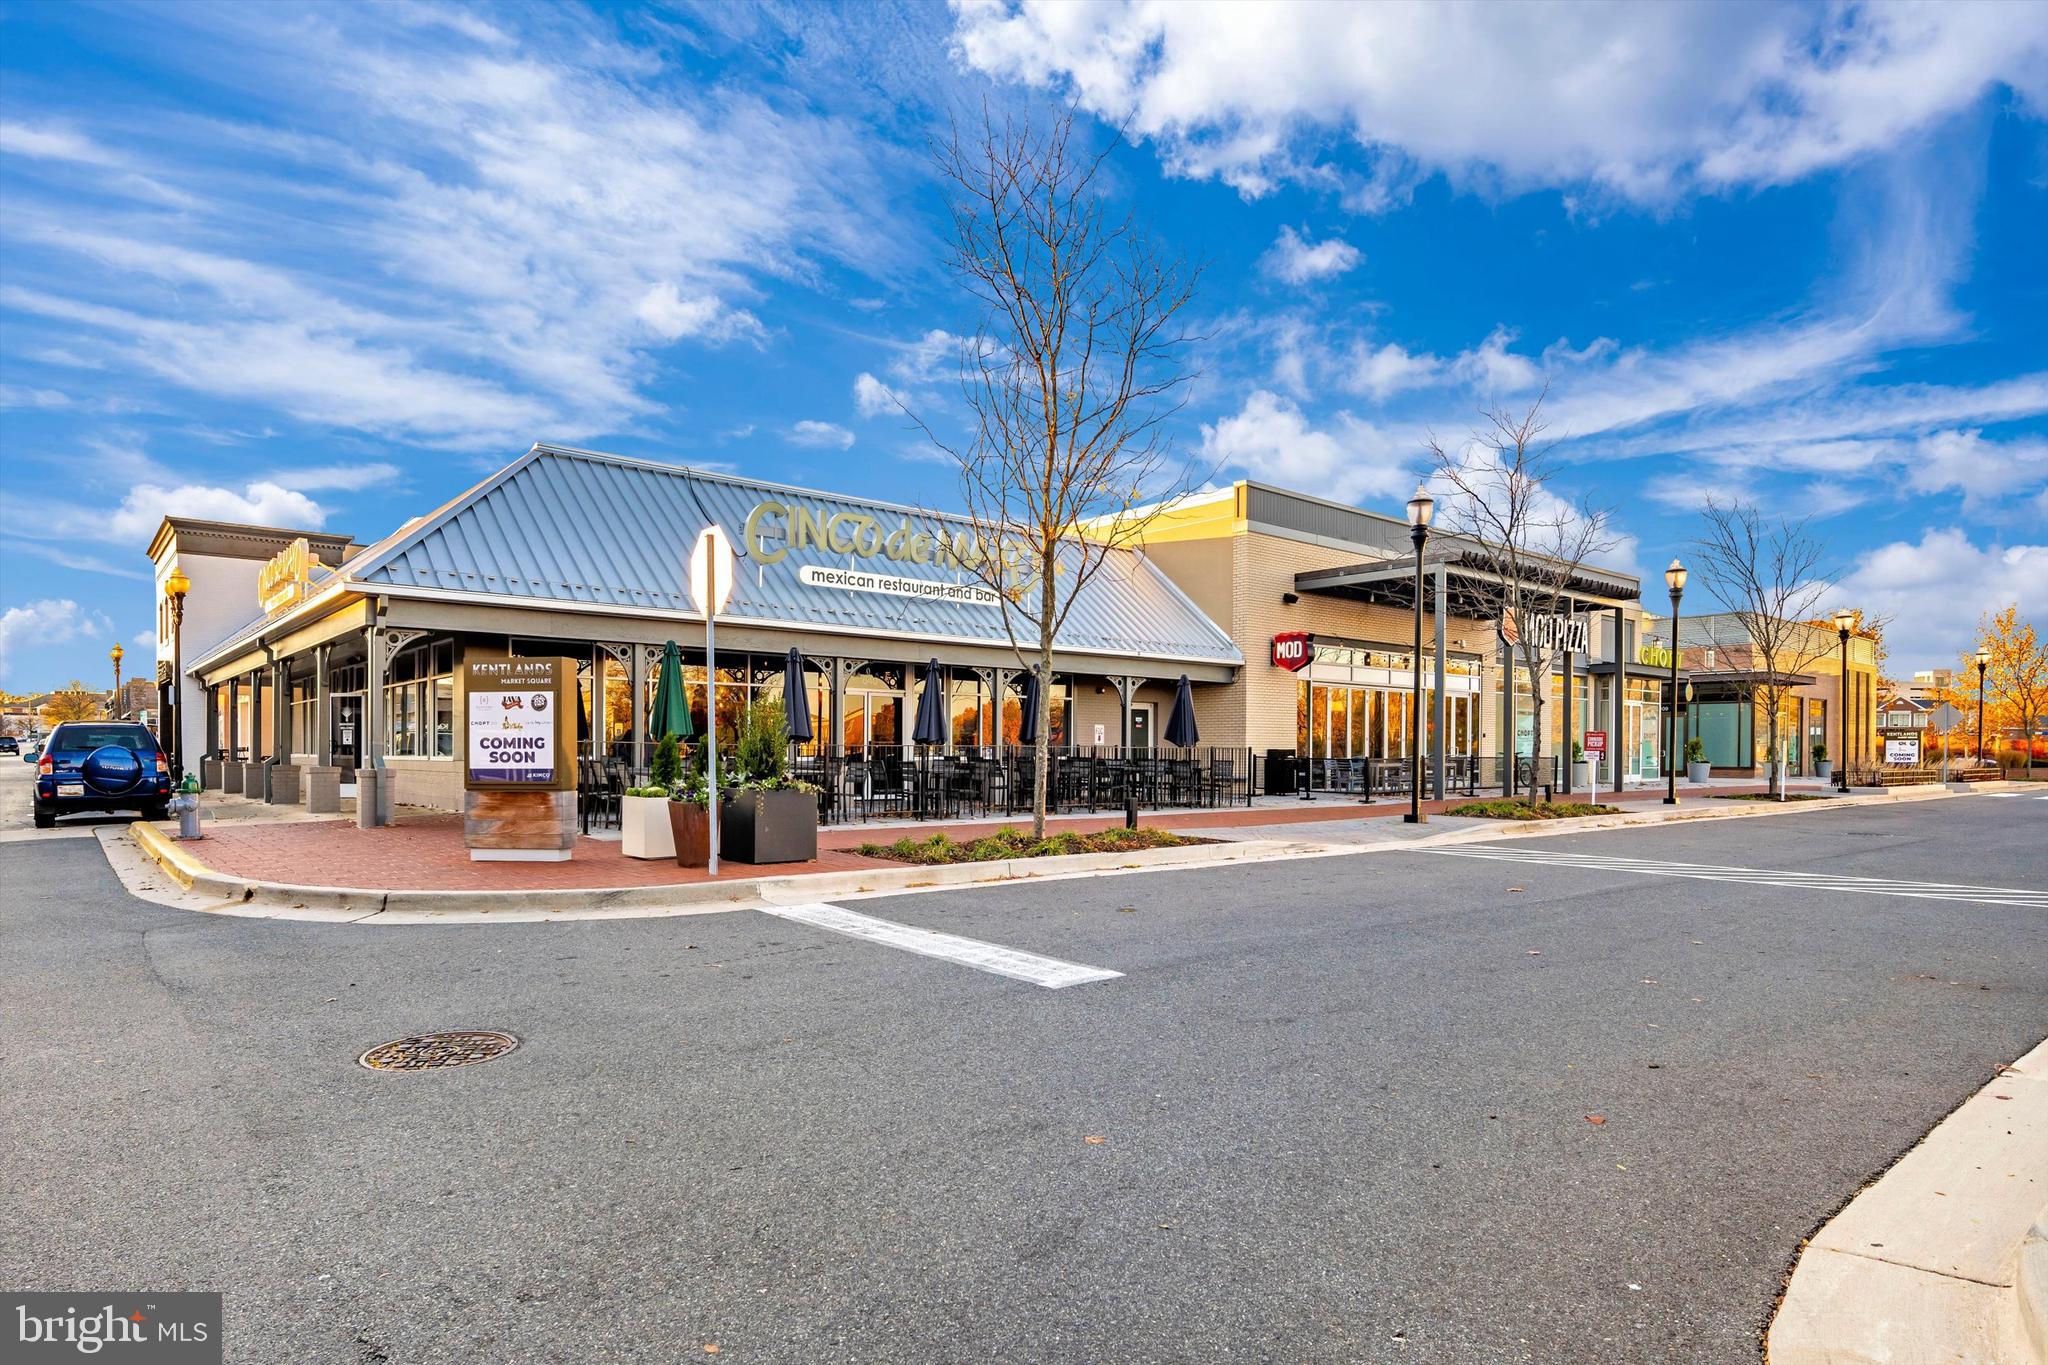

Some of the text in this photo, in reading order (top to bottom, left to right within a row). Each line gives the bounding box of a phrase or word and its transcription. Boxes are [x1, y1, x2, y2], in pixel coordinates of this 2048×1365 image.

[744, 501, 883, 565] CINCO
[886, 518, 931, 564] de
[811, 569, 996, 602] mexican restaurant and bar
[1555, 618, 1589, 654] PIZZA
[1276, 640, 1303, 659] MOD
[472, 663, 553, 676] KENTLANDS
[501, 677, 552, 685] MARKET SQUARE
[479, 737, 545, 750] COMING
[489, 751, 536, 764] SOON
